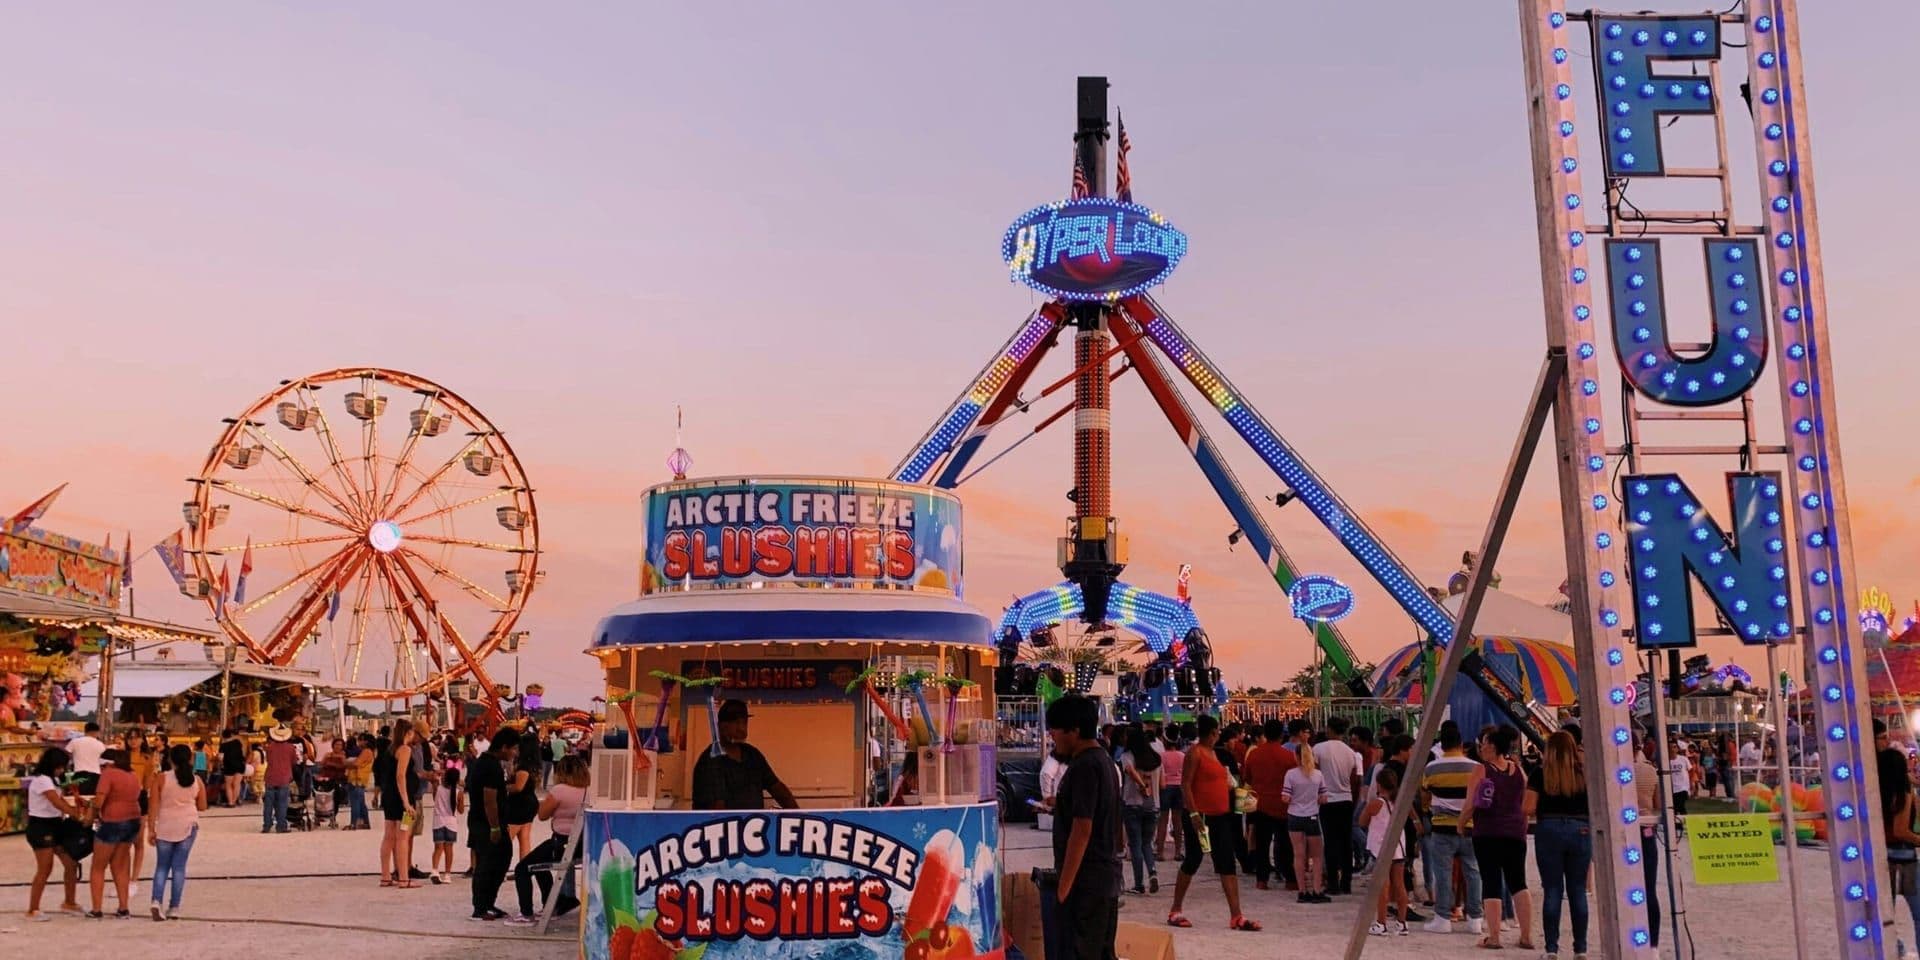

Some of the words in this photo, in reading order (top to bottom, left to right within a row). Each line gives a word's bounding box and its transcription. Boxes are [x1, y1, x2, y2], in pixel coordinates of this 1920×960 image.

[1010, 209, 1110, 280] HYPER
[1594, 14, 1797, 649] FUN
[666, 491, 780, 528] ARCTIC
[791, 491, 915, 529] FREEZE
[664, 527, 915, 579] SLUSHIES
[721, 668, 817, 689] SLUSHIES
[1697, 830, 1763, 839] WANTED
[1707, 820, 1749, 828] HELP
[635, 816, 768, 893] ARCTIC
[779, 815, 918, 889] FREEZE
[655, 876, 892, 940] SLUSHIES
